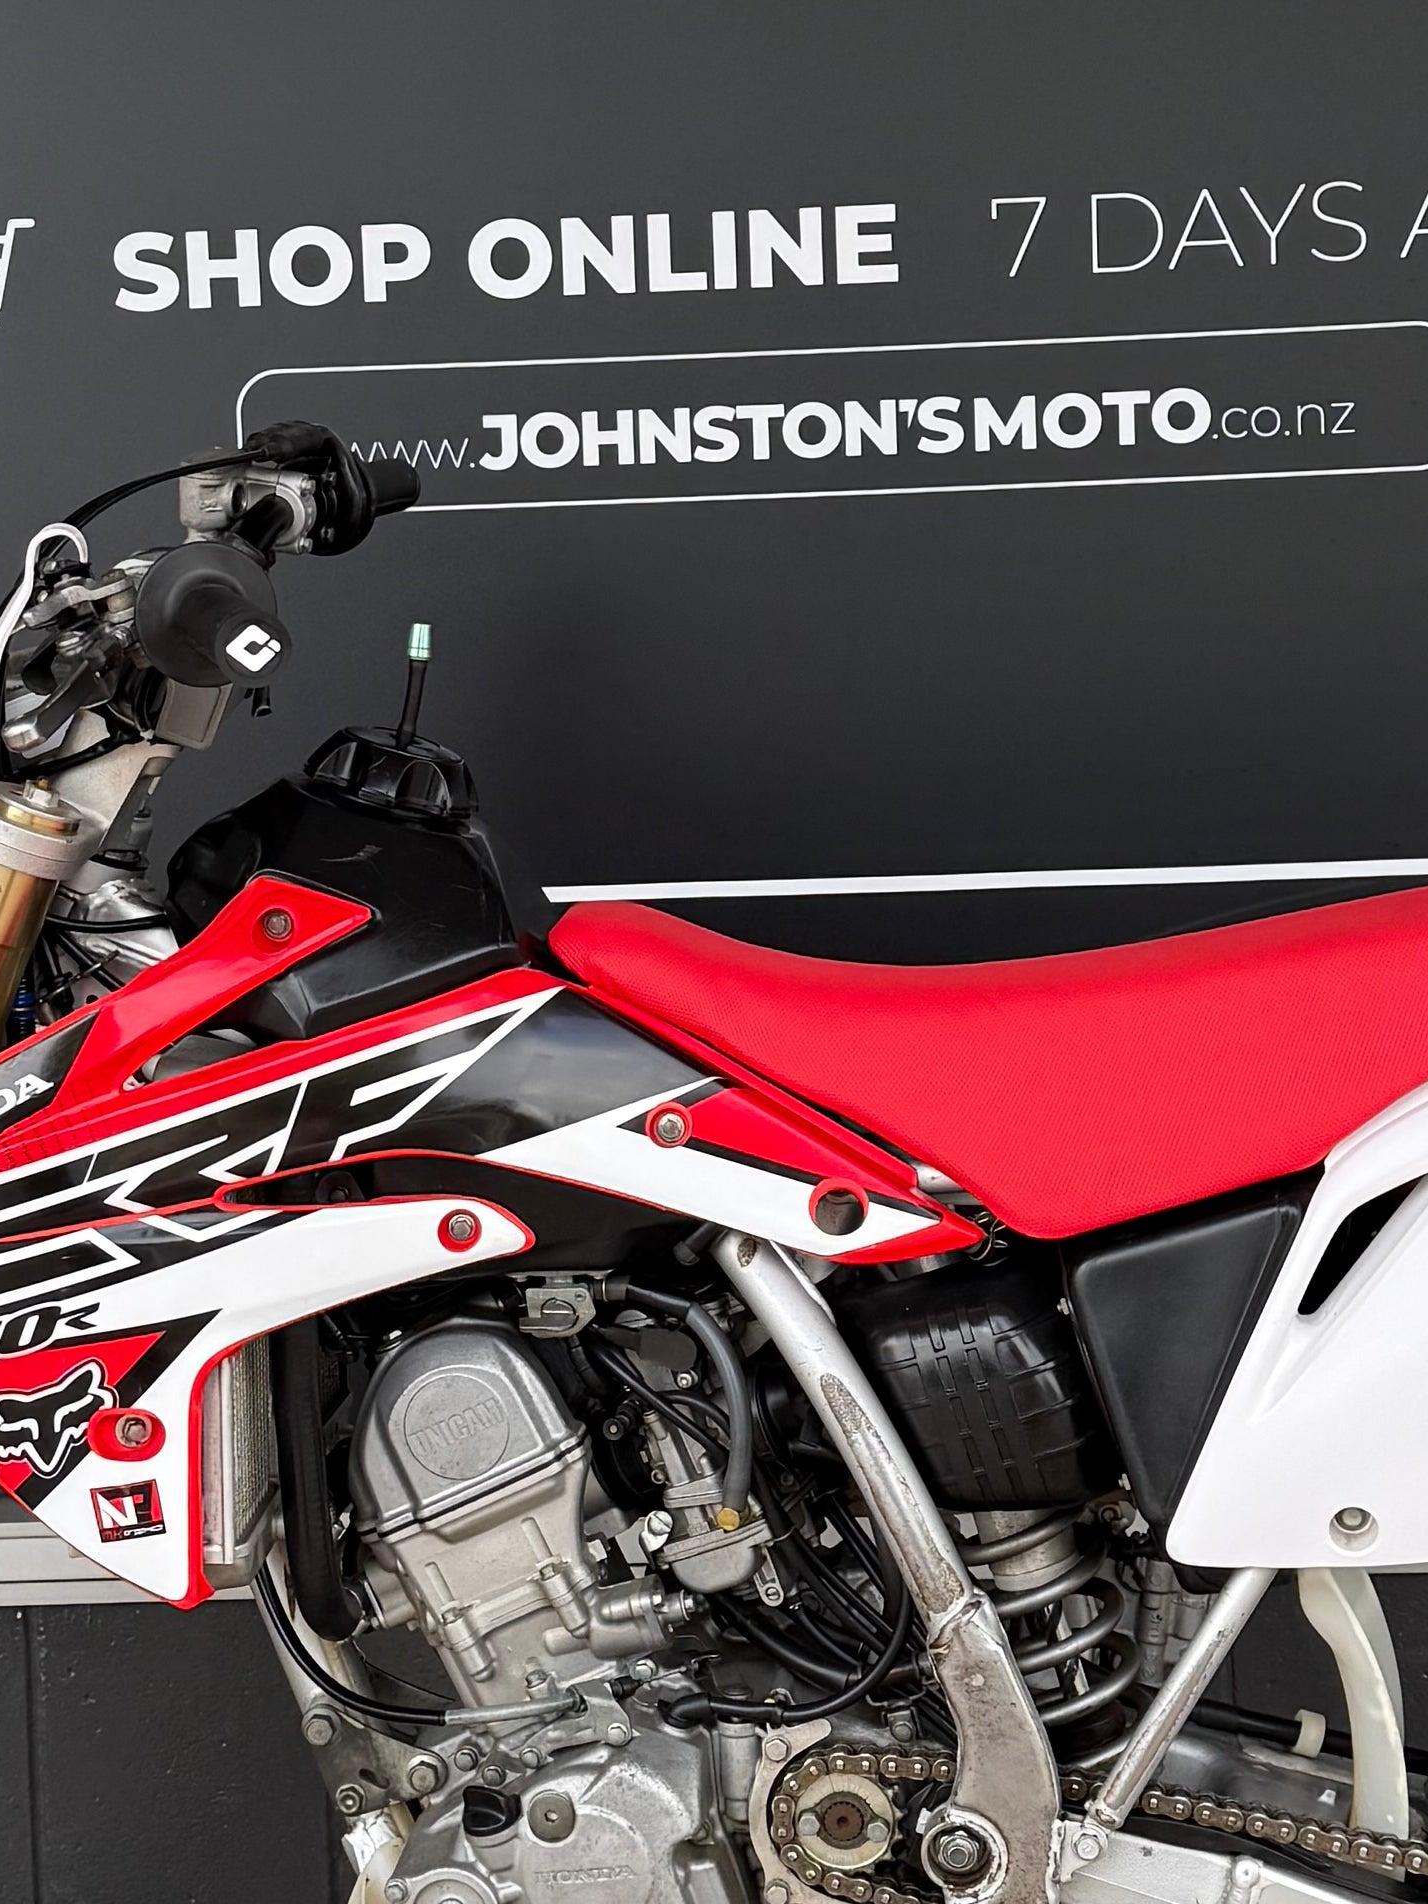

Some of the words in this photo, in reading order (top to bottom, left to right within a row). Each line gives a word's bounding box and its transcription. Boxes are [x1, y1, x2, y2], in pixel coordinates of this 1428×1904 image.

[112, 223, 431, 313] SHOP
[467, 203, 899, 300] ONLINE
[989, 196, 1047, 278] 7
[1091, 180, 1368, 275] DAYS
[408, 1396, 504, 1457] UNICAM
[534, 1864, 637, 1885] HONDA
